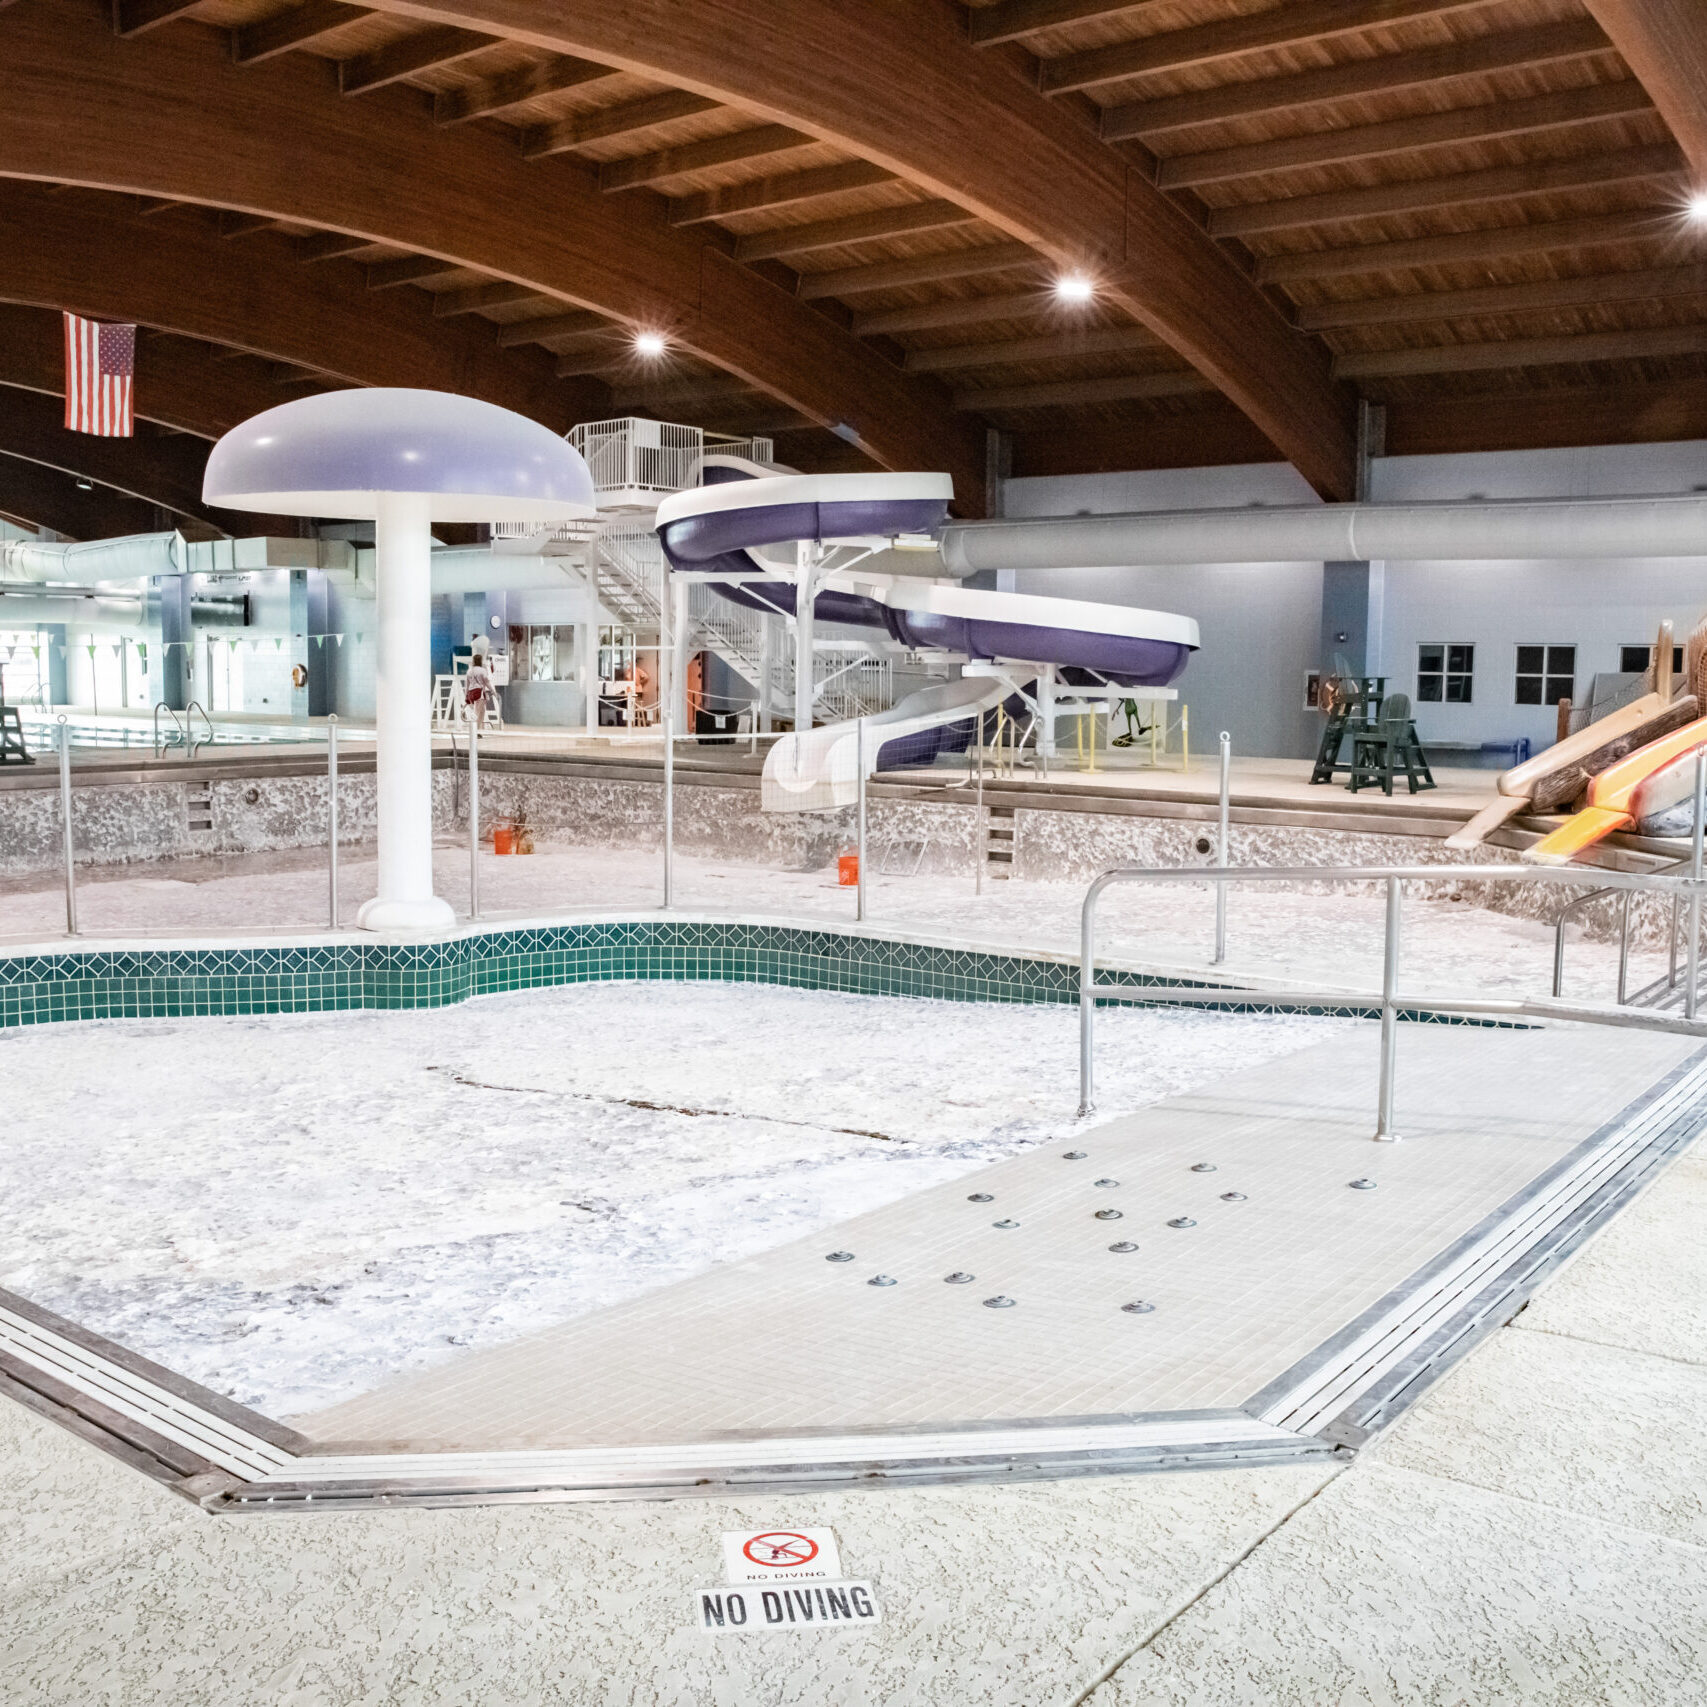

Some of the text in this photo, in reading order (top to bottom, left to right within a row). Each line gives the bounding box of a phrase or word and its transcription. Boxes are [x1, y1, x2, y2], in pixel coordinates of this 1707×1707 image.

[774, 1571, 826, 1579] DIVING
[702, 1586, 875, 1627] NO DIVING
